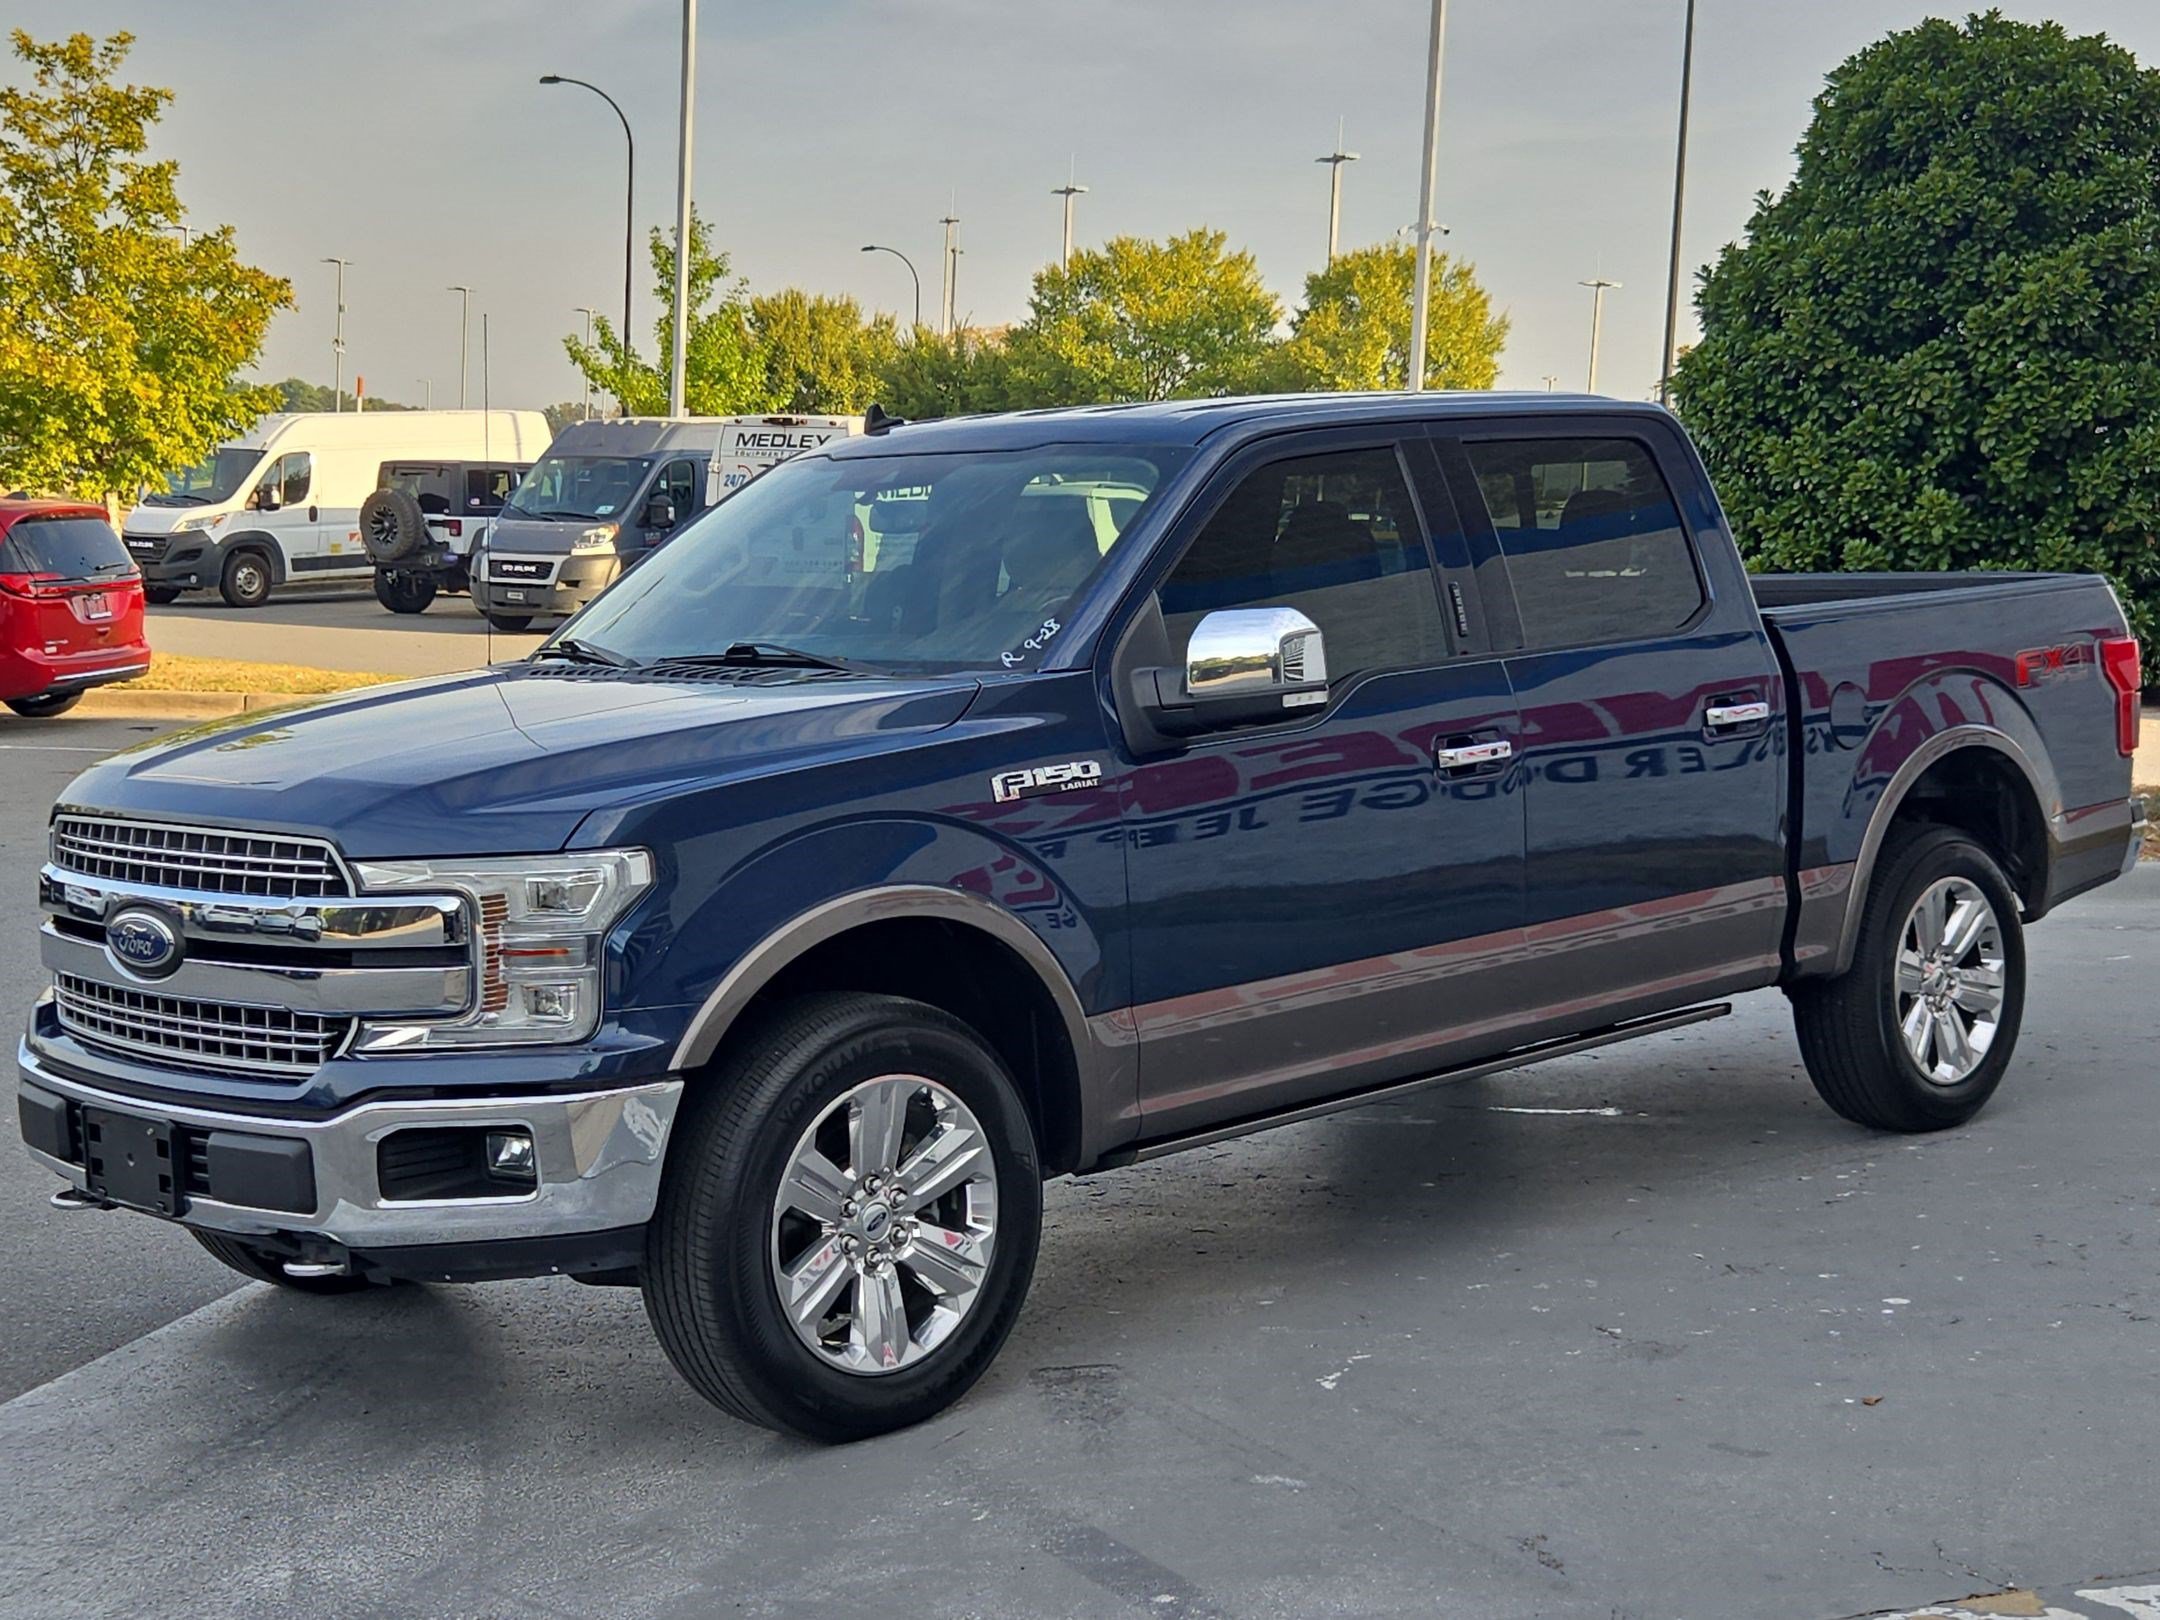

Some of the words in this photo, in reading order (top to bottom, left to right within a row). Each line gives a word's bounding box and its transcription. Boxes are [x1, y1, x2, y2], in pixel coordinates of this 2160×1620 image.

[735, 432, 832, 448] MEDLEY
[723, 474, 747, 488] 24/7
[1024, 618, 1061, 650] 9-28
[2015, 641, 2087, 689] FX4
[991, 759, 1102, 803] F150
[1060, 778, 1099, 791] LARIAT
[118, 923, 156, 956] Ford
